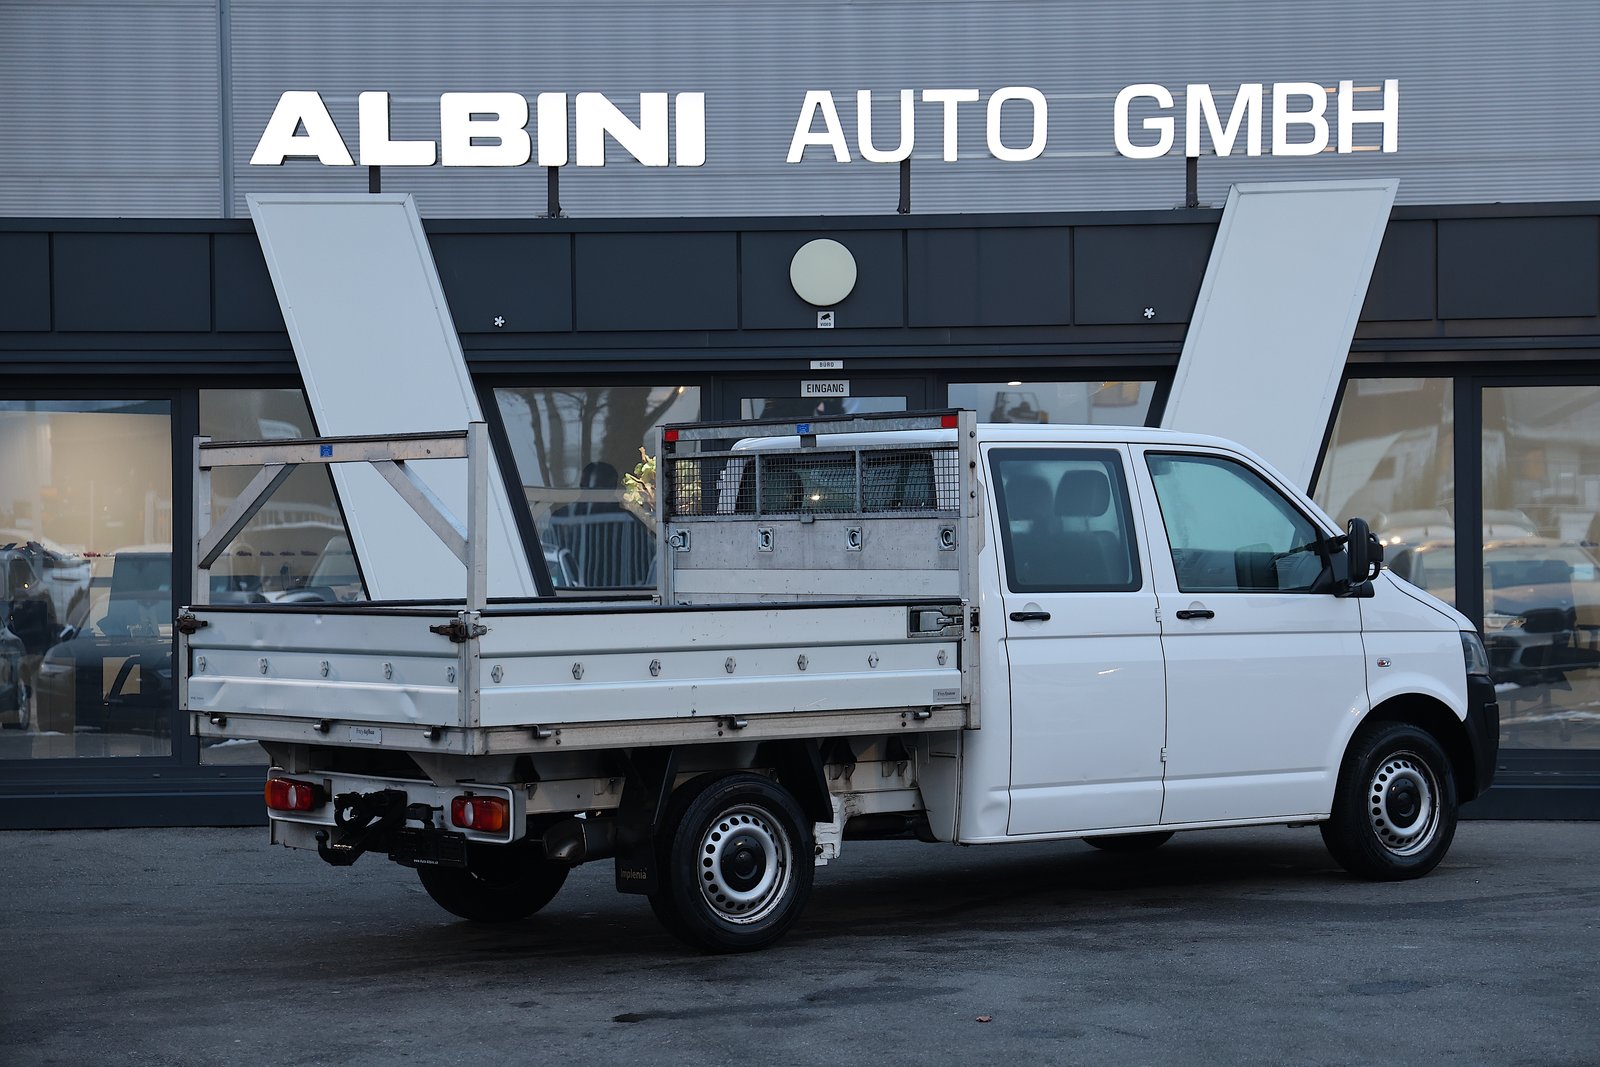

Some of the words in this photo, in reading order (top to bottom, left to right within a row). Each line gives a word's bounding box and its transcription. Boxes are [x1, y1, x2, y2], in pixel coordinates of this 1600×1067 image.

[250, 91, 706, 167] ALBINI
[786, 87, 1048, 164] AUTO
[1114, 79, 1399, 159] GMBH
[806, 384, 844, 393] EINGANG
